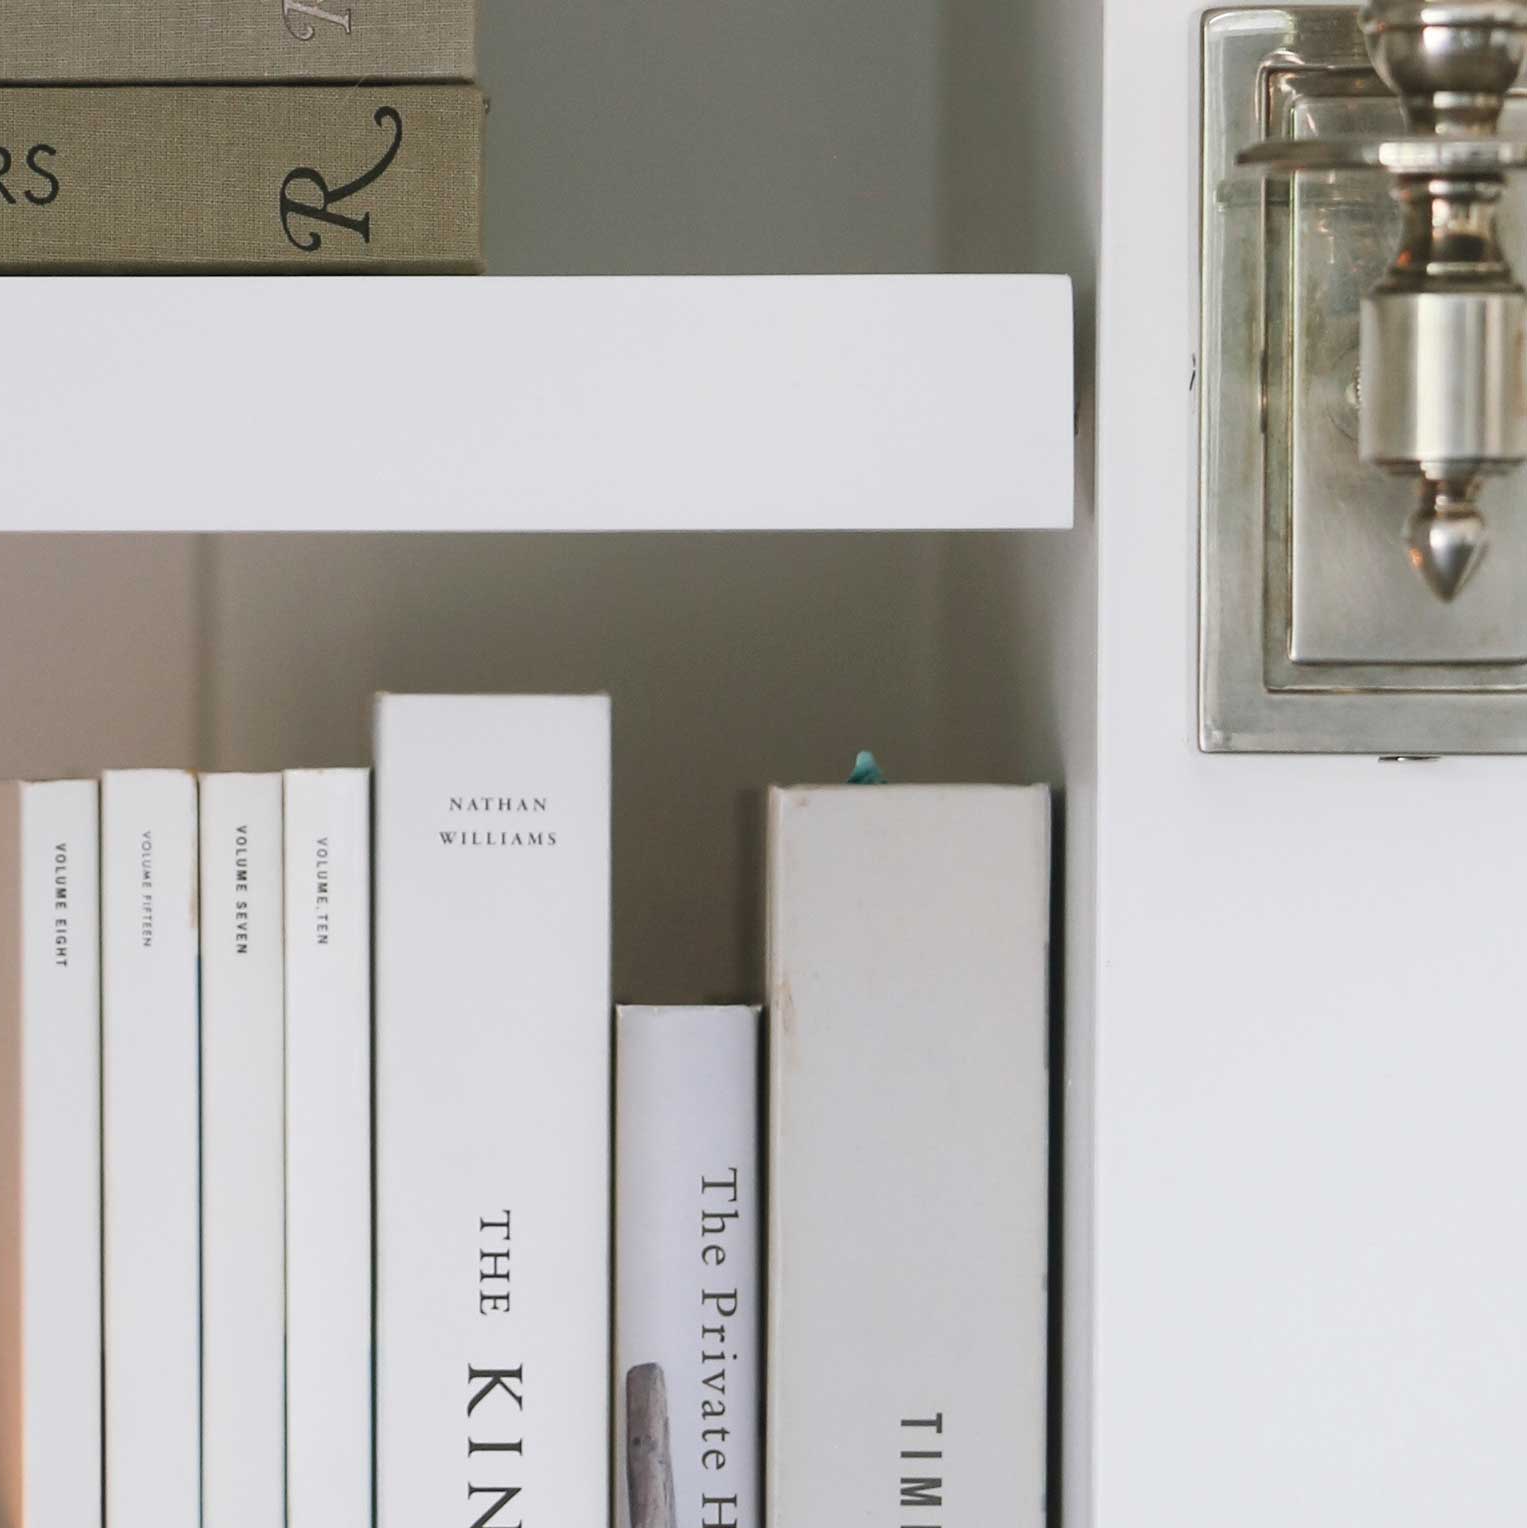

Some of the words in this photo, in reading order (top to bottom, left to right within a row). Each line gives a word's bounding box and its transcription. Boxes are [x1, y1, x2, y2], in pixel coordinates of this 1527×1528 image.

[449, 797, 546, 812] NATHAN
[141, 831, 152, 888] VOLUME
[235, 825, 248, 891] VOLUME
[439, 831, 556, 846] WILLIAMS
[55, 843, 67, 909] VOLUME
[55, 918, 68, 967] EIGHT
[142, 894, 153, 947] FIFTEEN
[235, 901, 248, 954] SEVEN
[316, 914, 329, 945] TEN
[701, 1167, 740, 1266] The
[479, 1209, 511, 1316] THE
[701, 1287, 738, 1471] Private
